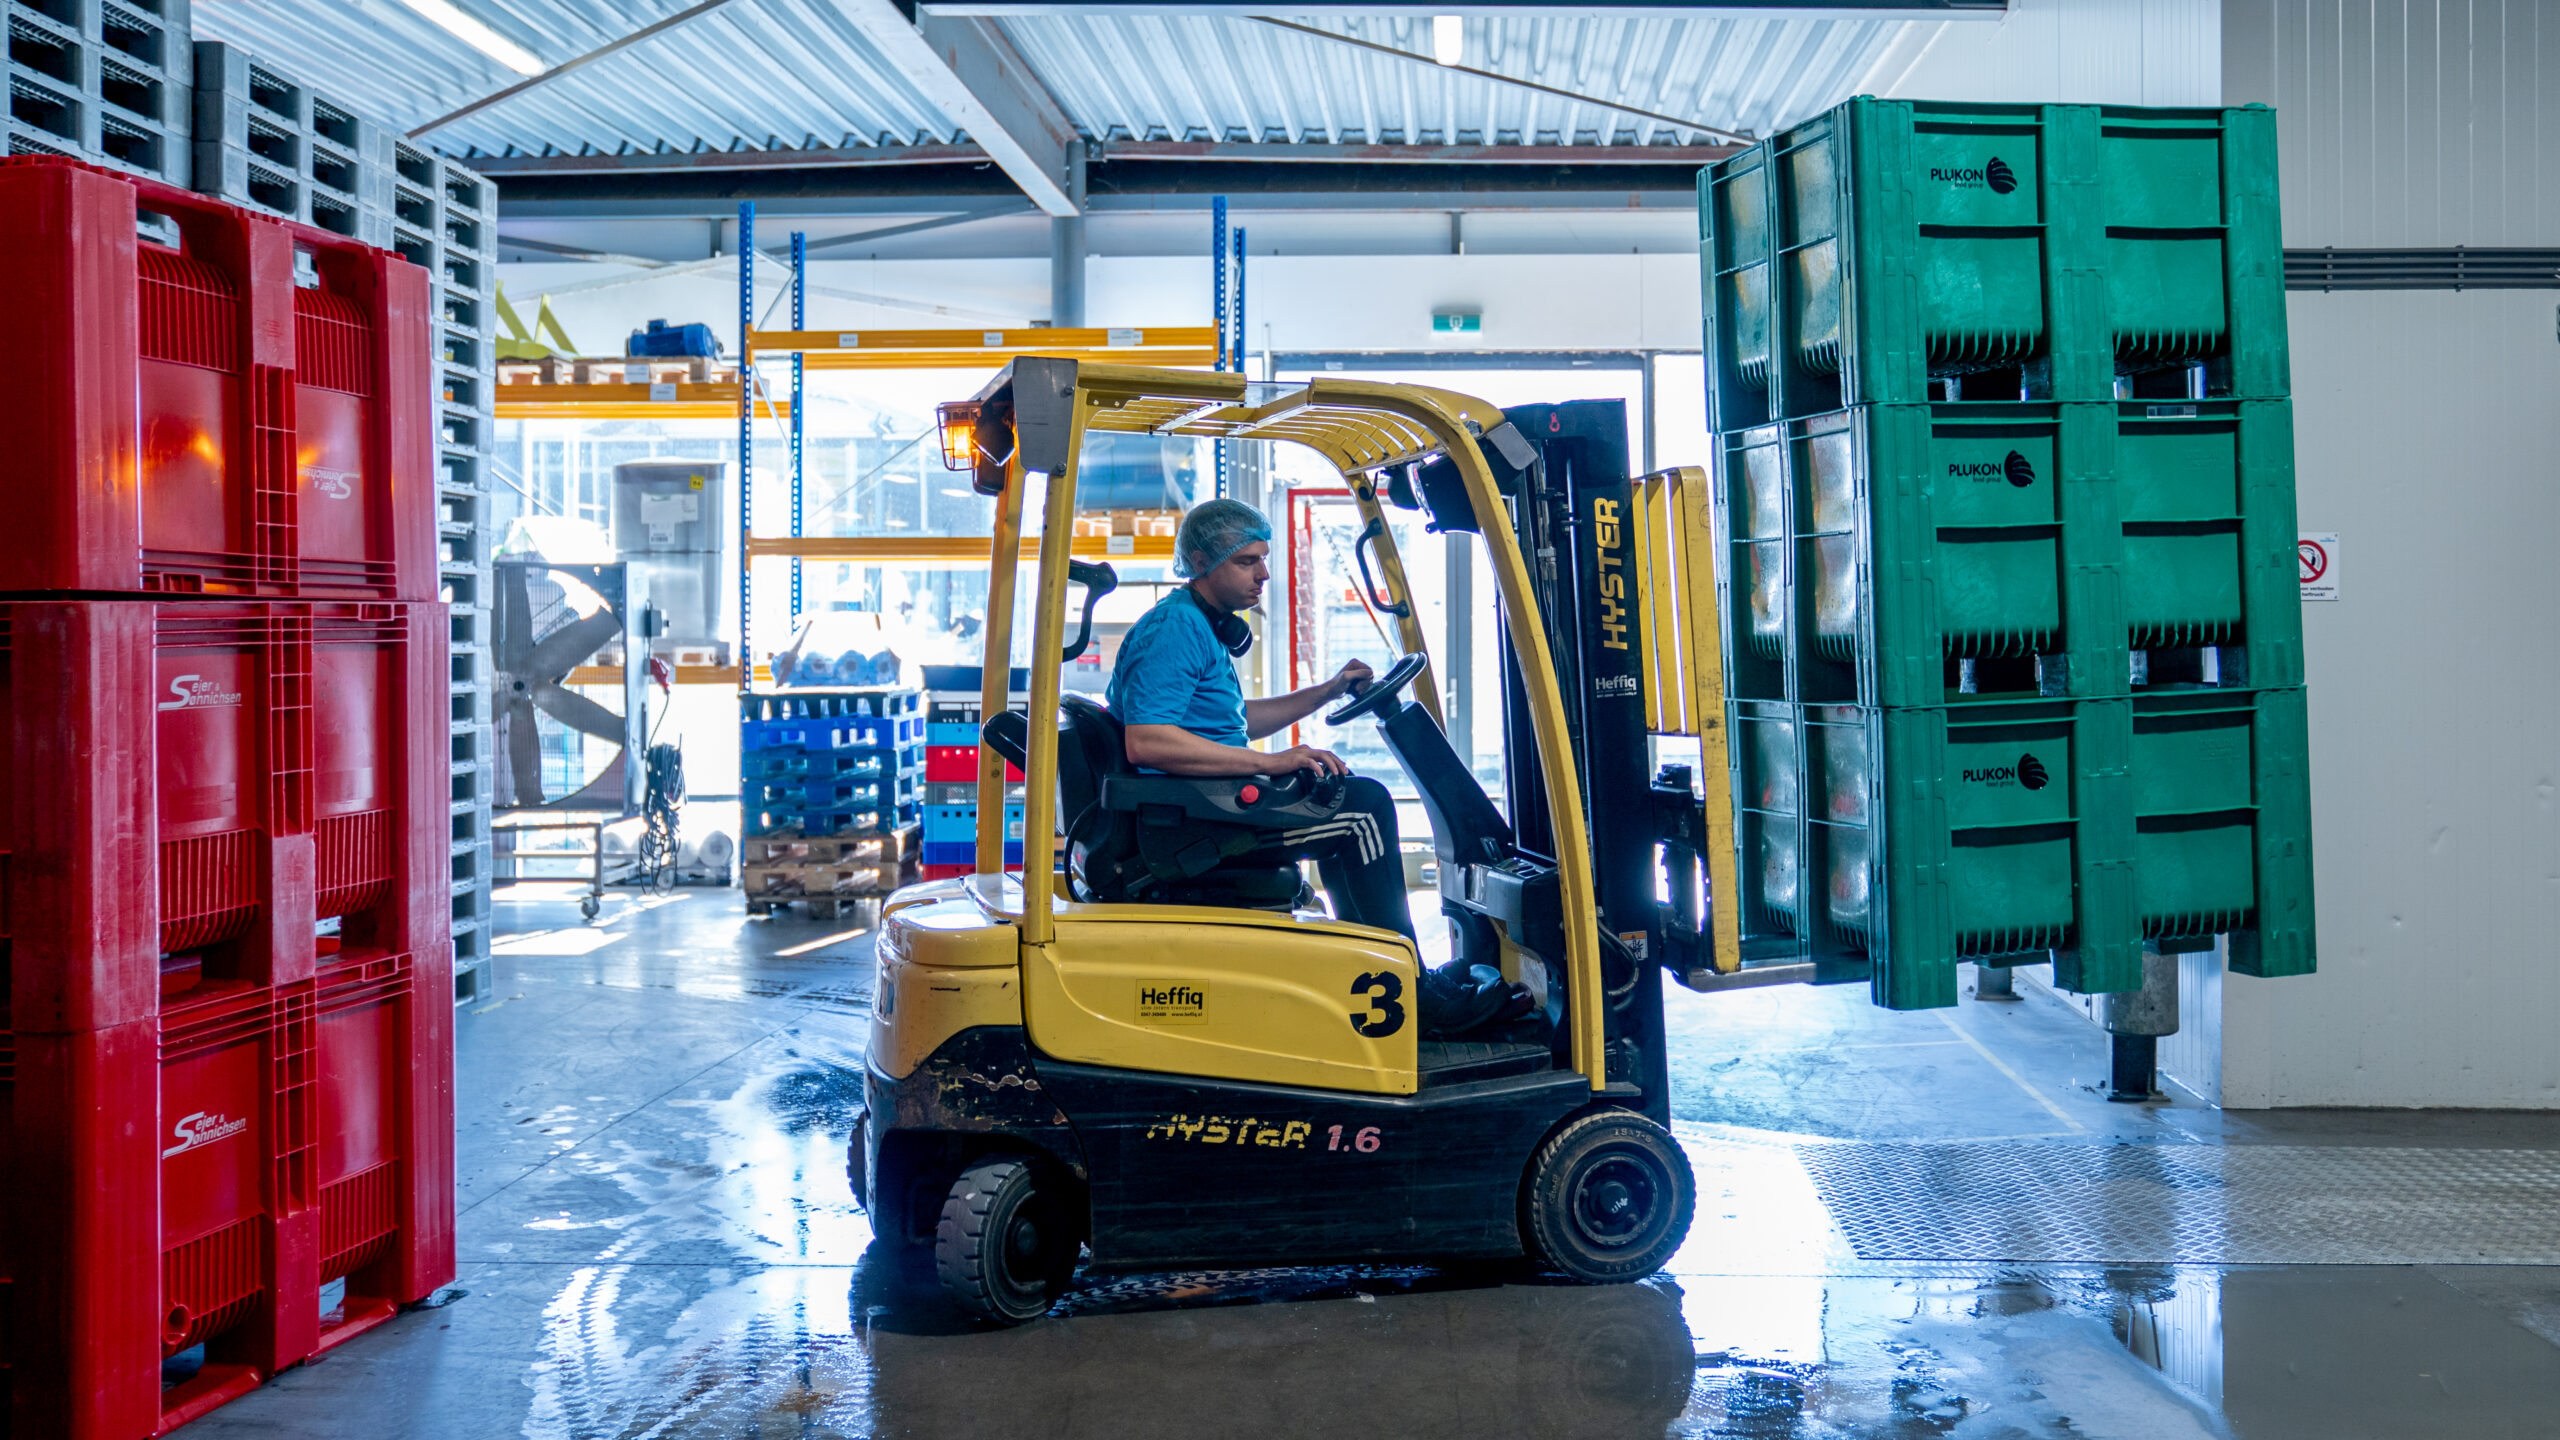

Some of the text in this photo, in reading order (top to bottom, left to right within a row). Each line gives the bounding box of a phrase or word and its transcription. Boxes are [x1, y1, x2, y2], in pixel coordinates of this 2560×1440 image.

[1930, 168, 1984, 181] PLUKON
[1949, 463, 2002, 477] PLUKON
[1594, 497, 1628, 650] HYSTER
[1595, 675, 1637, 691] Heffiq
[1962, 766, 2015, 783] PLUKON
[1141, 986, 1203, 1010] Heffiq
[1349, 971, 1405, 1038] 3
[1327, 1124, 1381, 1153] 1.6
